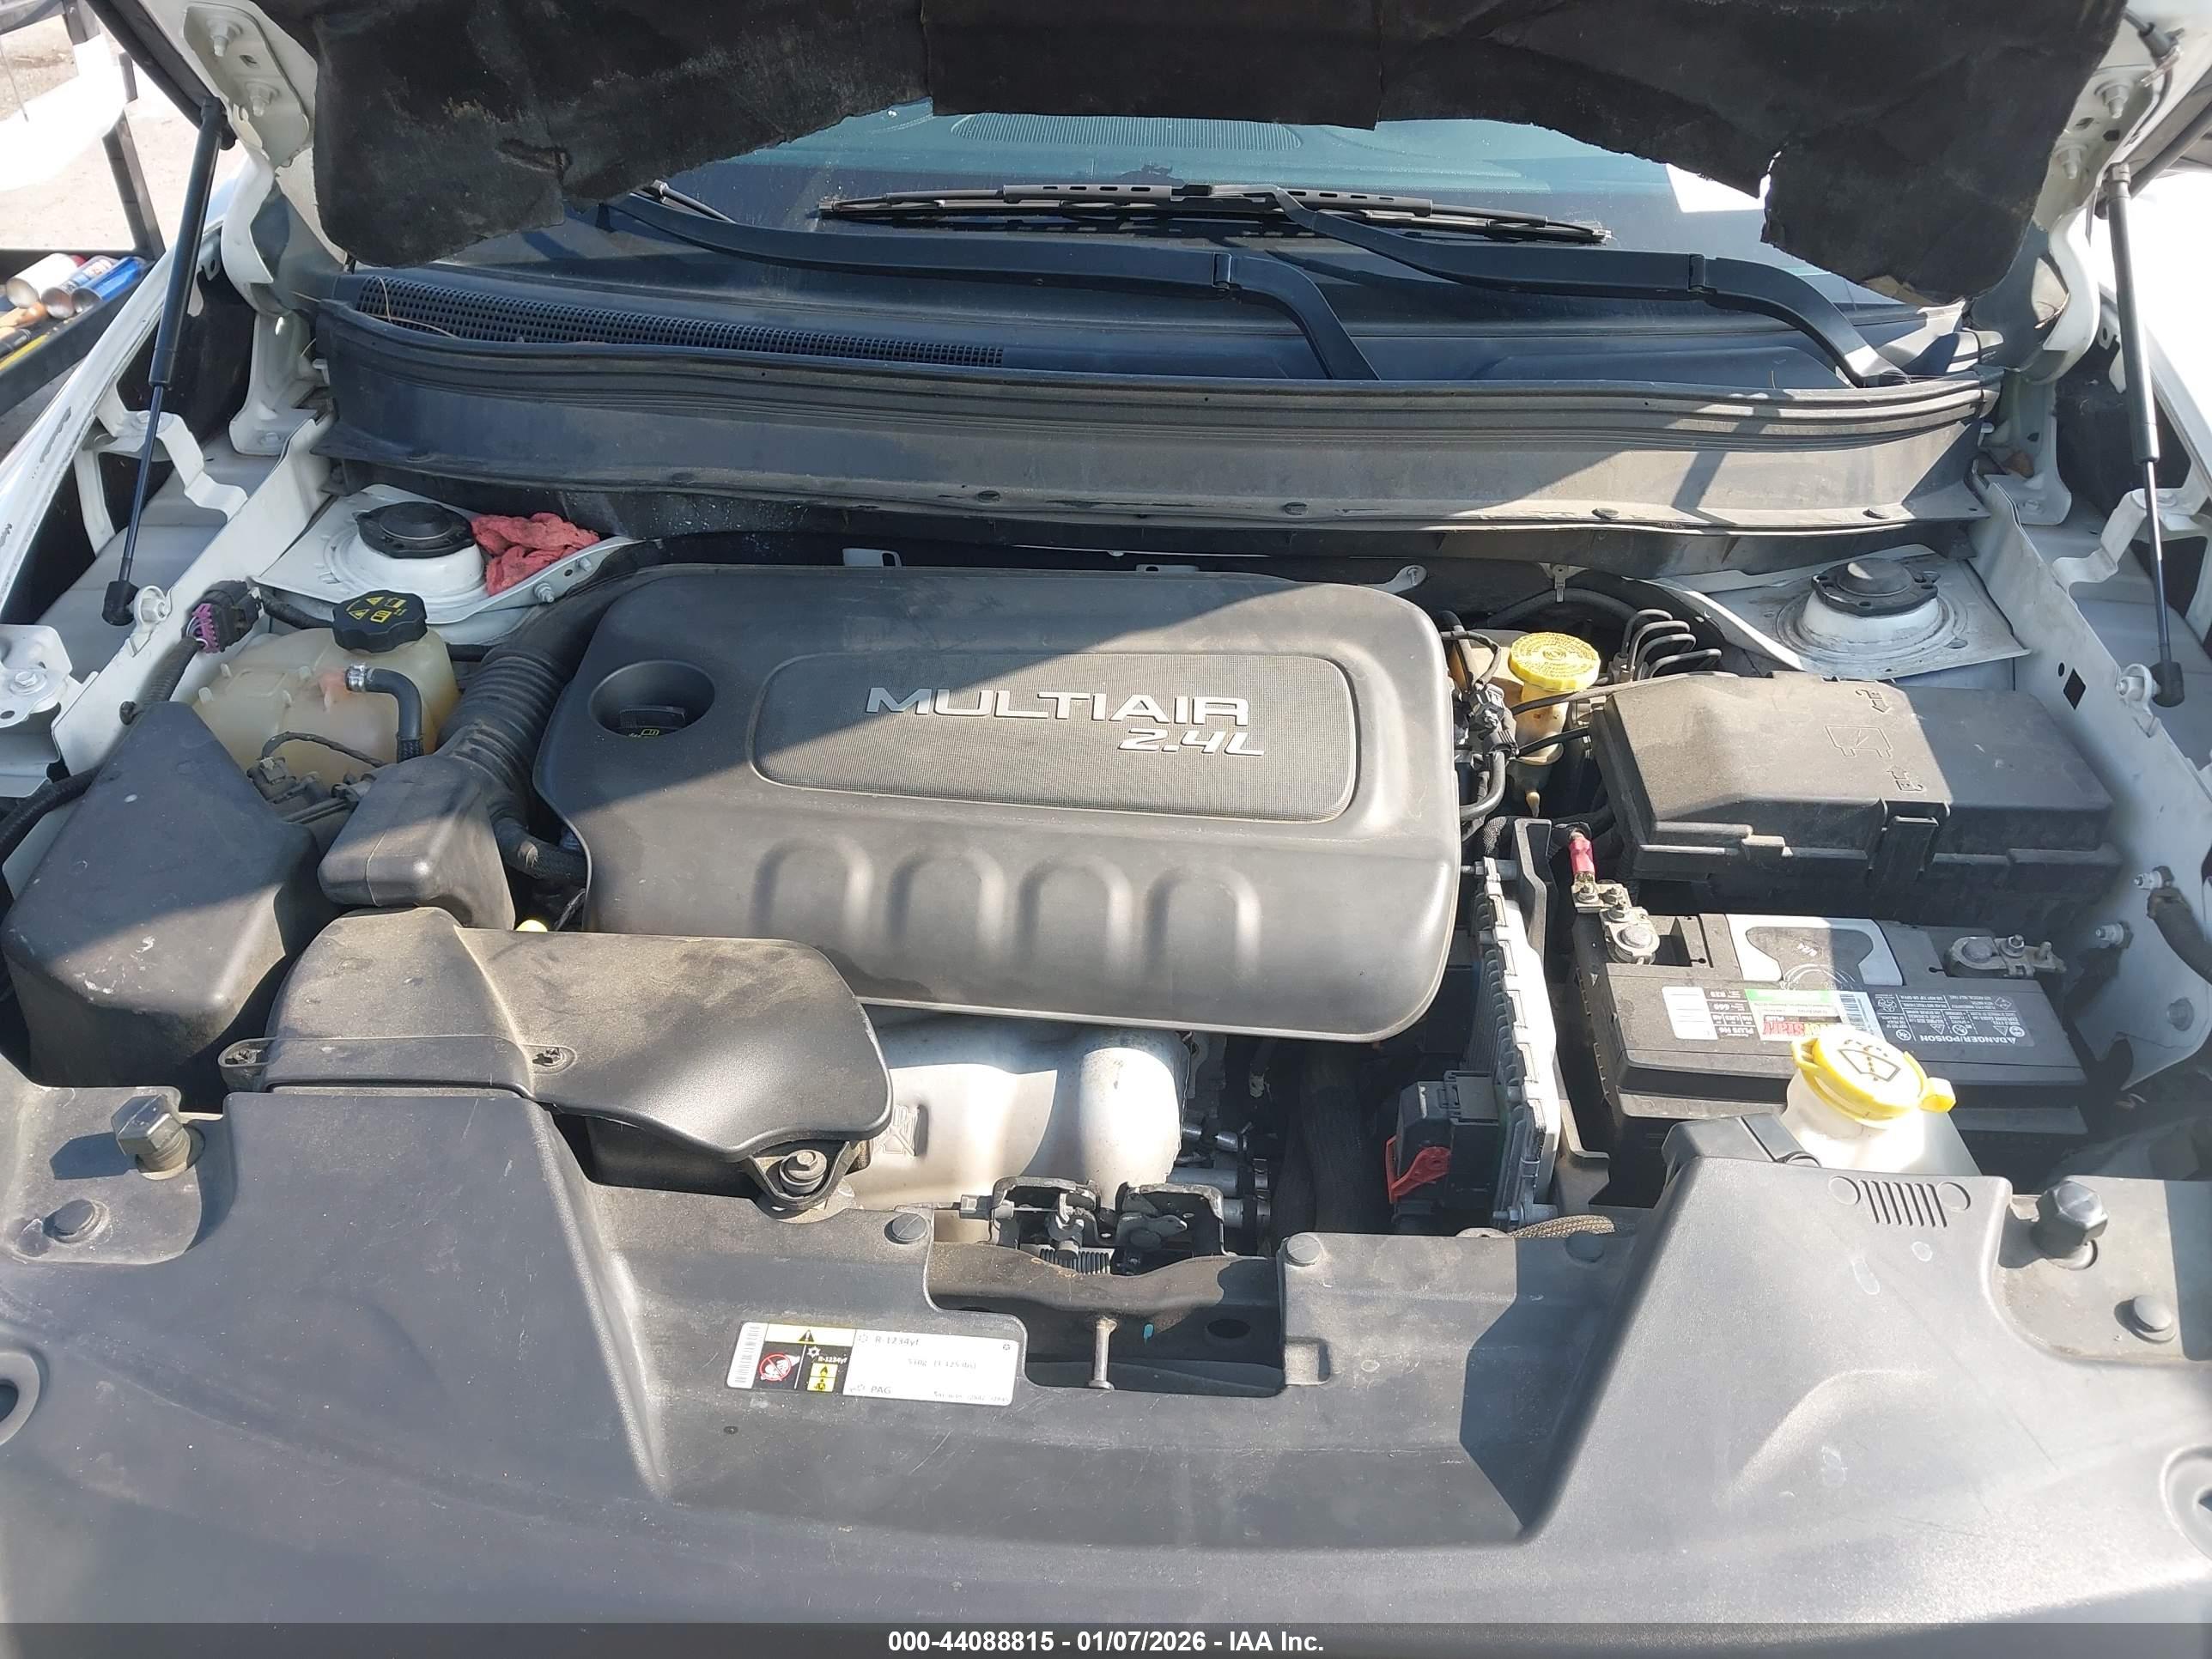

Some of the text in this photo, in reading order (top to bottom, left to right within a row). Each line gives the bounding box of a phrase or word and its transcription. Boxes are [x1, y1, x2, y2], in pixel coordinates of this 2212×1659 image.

[865, 686, 1250, 726] MULTIAIR
[1117, 727, 1266, 757] 2.4L
[1919, 1034, 2008, 1044] DANGER/POISON
[874, 1335, 921, 1348] R-1234yf
[870, 1384, 892, 1395] PAG
